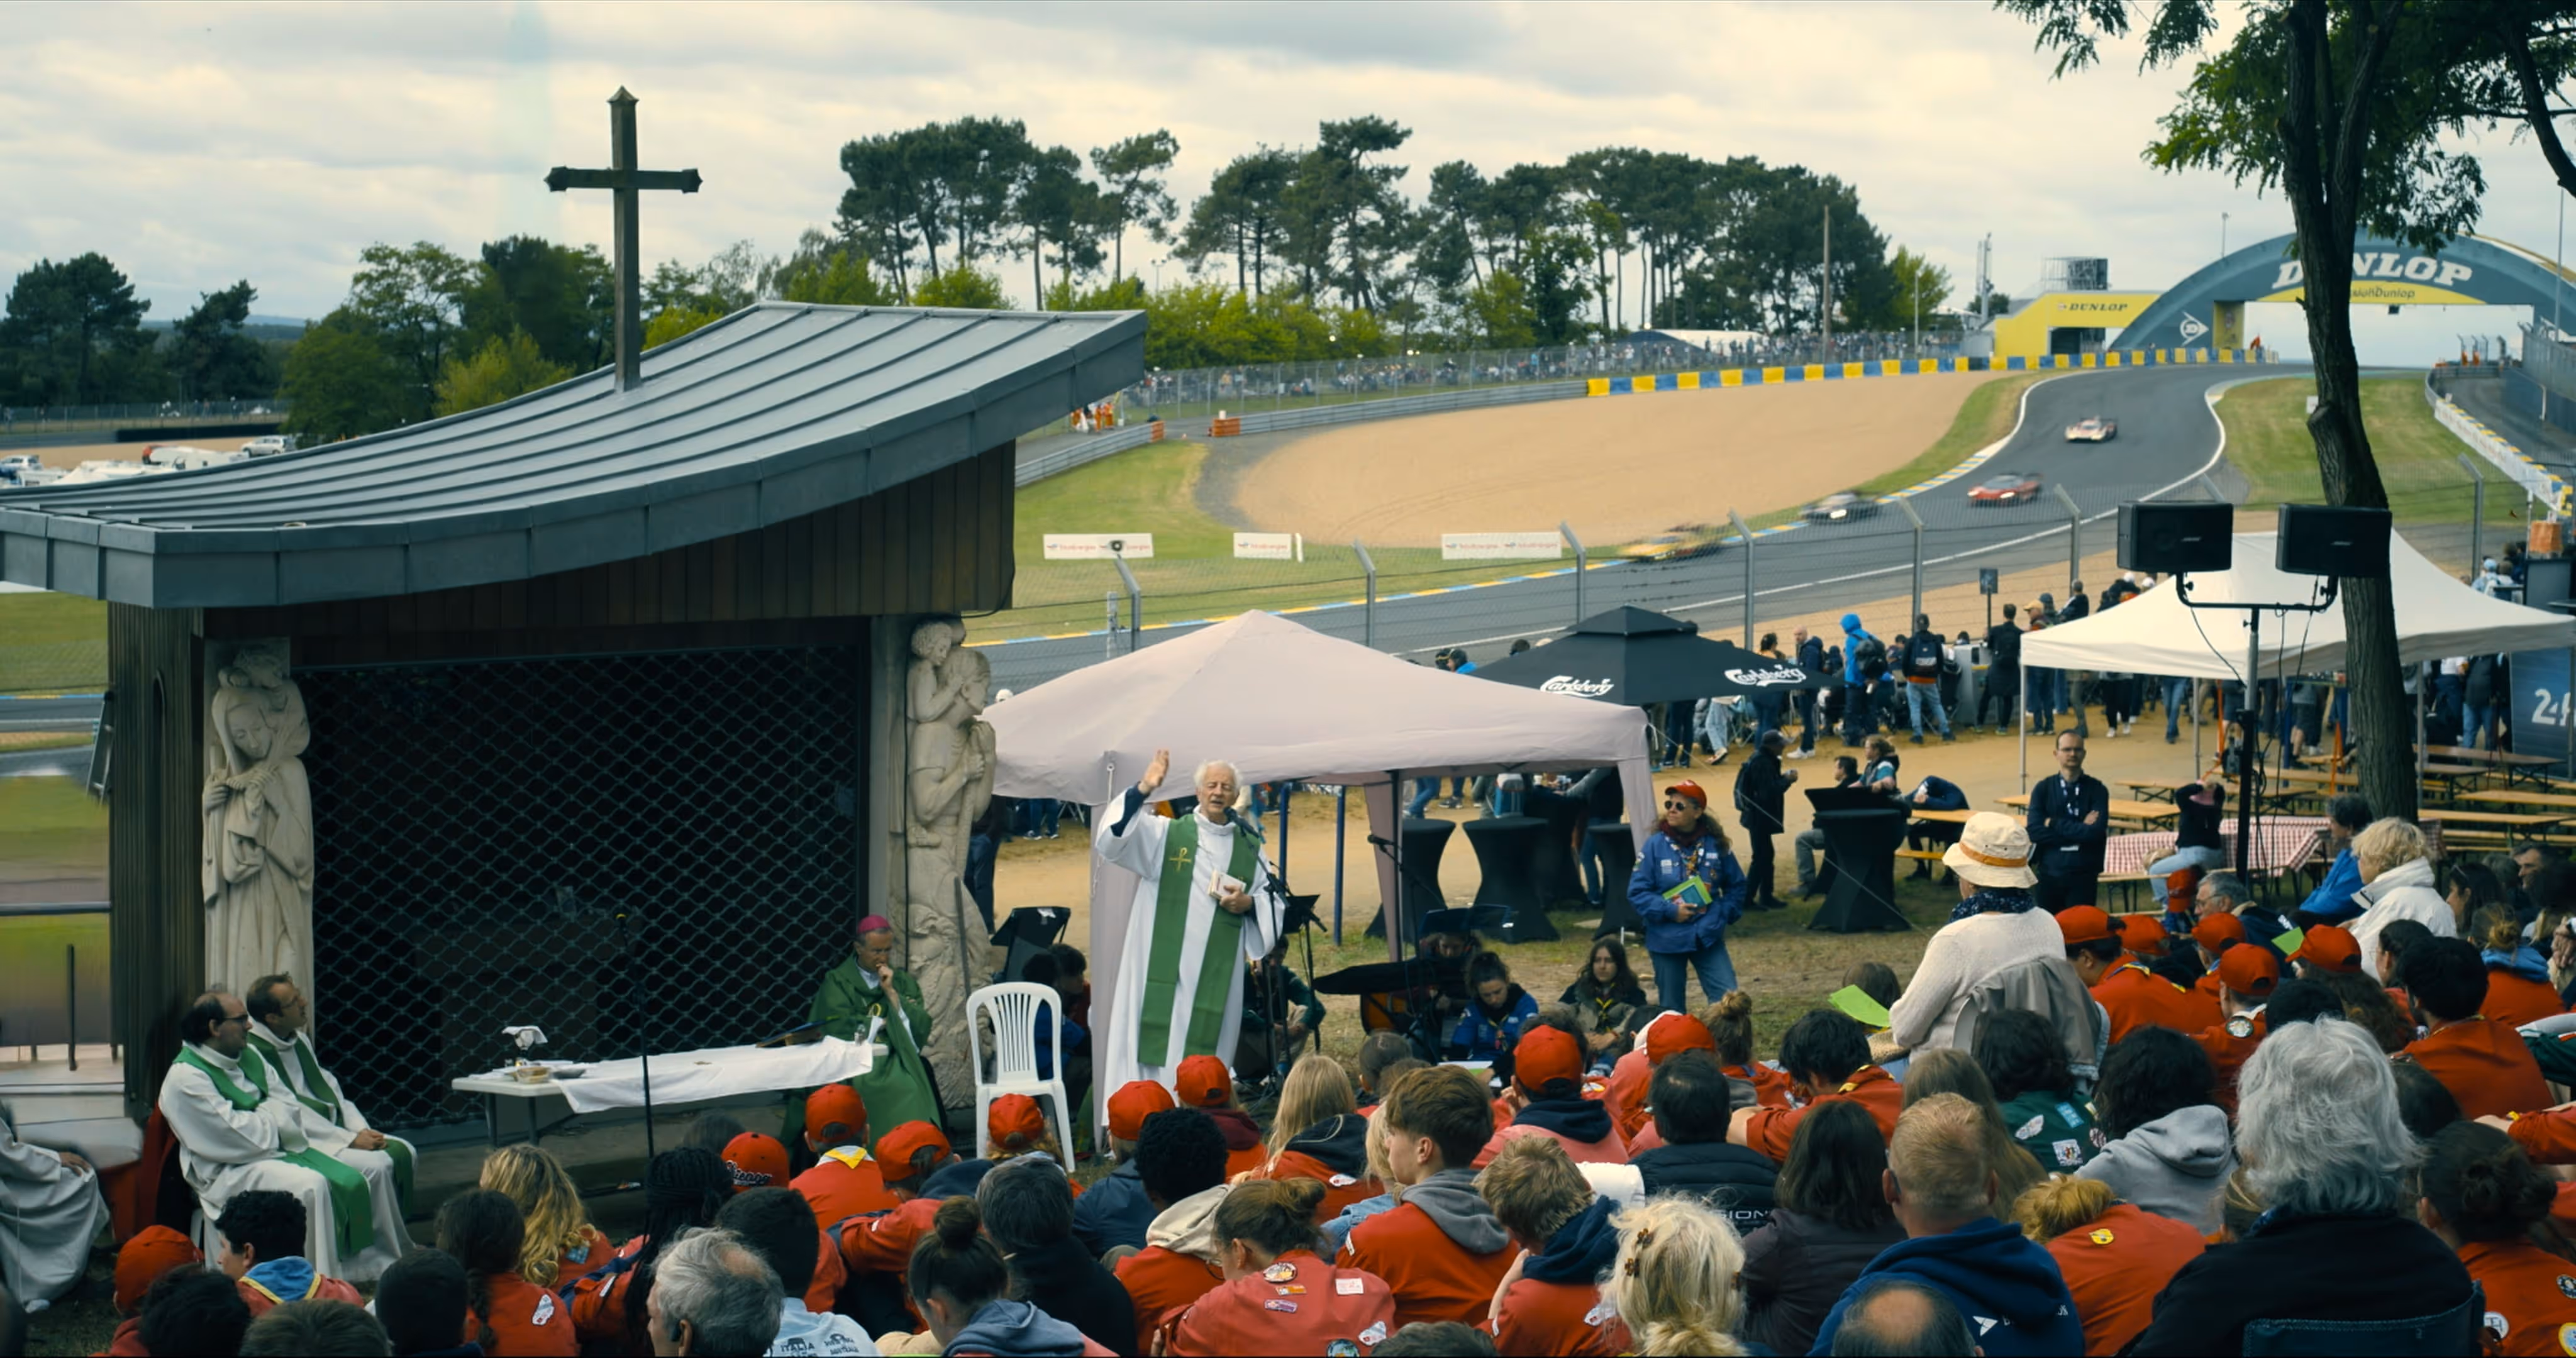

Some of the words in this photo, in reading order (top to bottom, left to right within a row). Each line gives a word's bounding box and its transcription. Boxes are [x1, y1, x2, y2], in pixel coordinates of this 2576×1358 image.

[2272, 252, 2472, 289] DNLOP
[2069, 303, 2128, 311] DUNLOP
[1540, 675, 1614, 697] Carlsberg
[1725, 665, 1806, 687] Carlsberg
